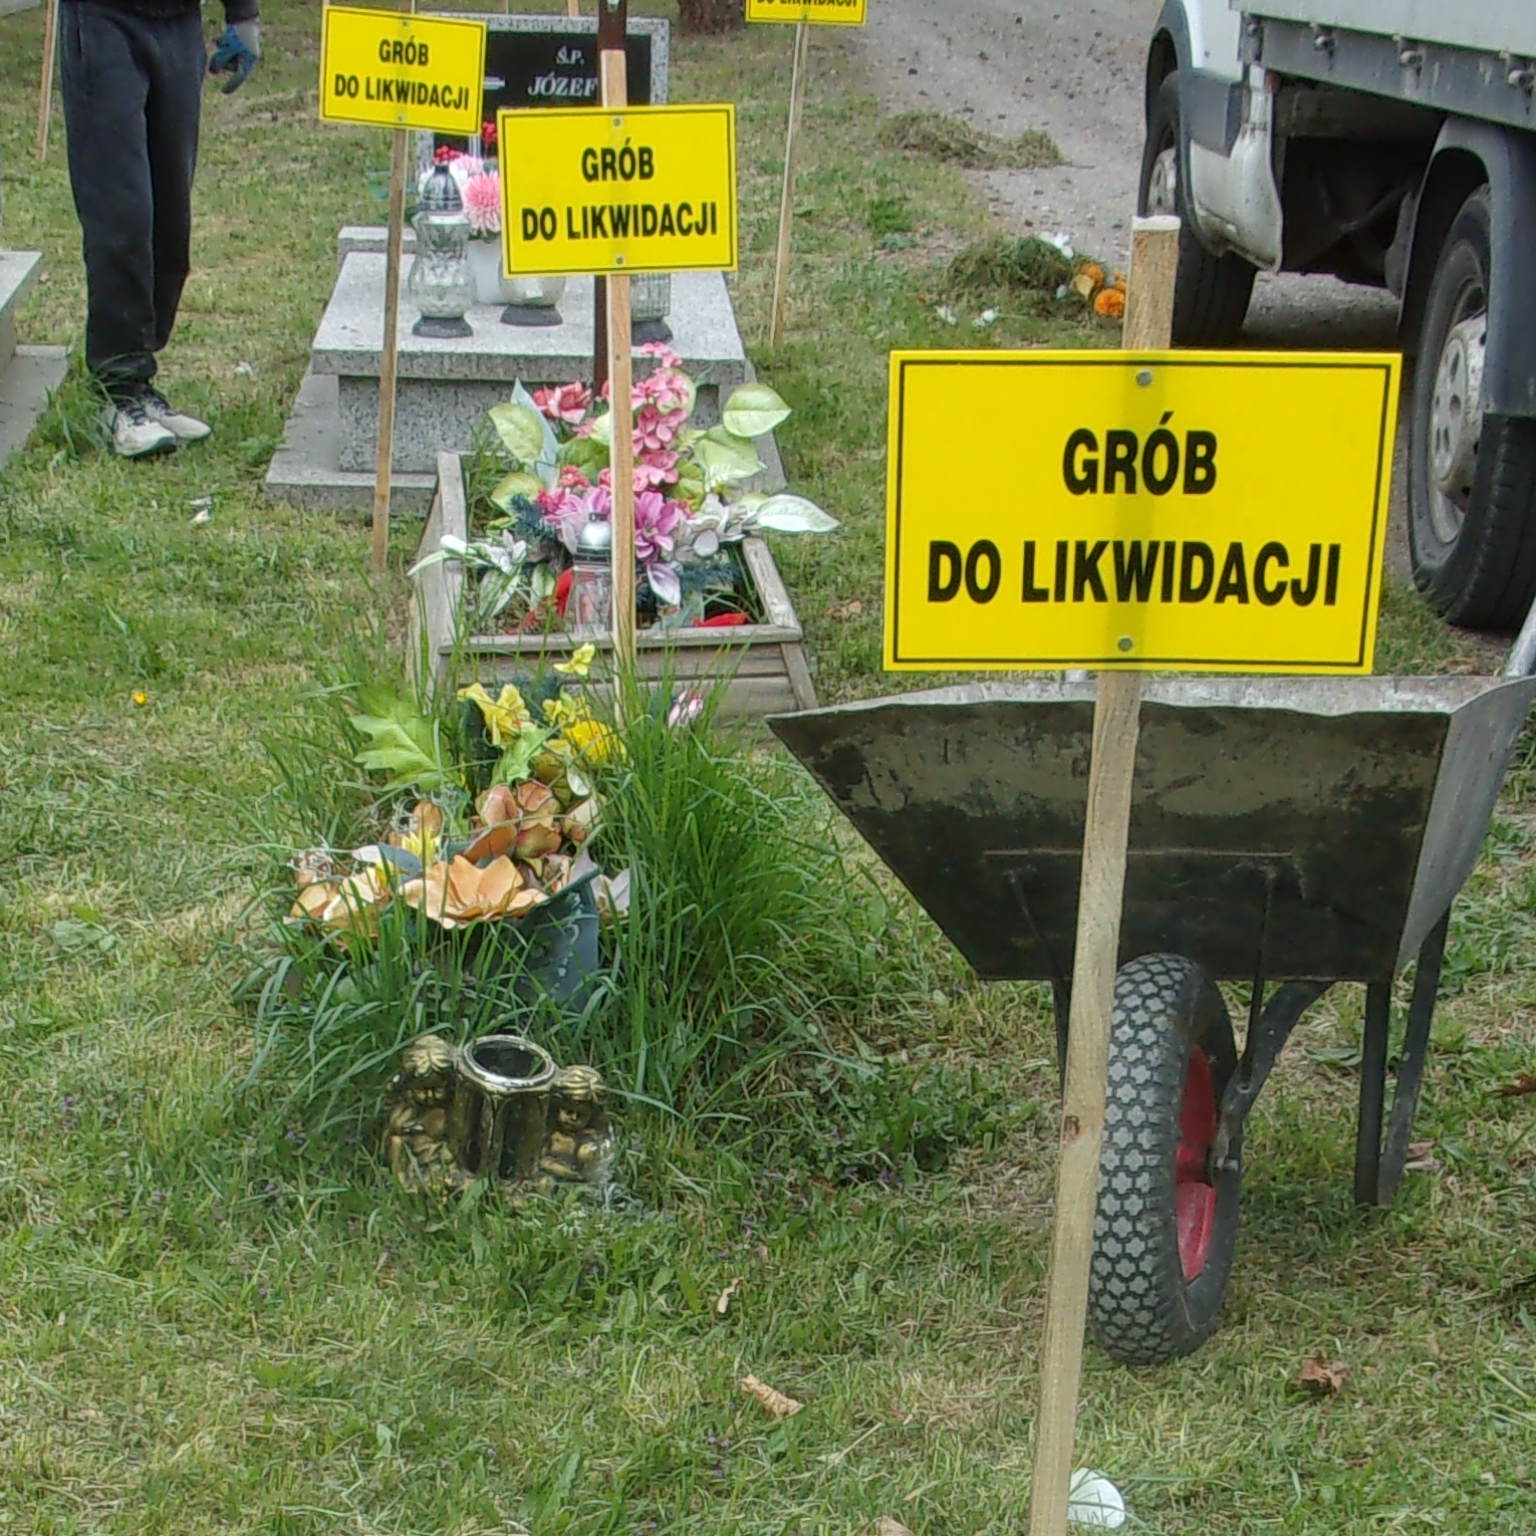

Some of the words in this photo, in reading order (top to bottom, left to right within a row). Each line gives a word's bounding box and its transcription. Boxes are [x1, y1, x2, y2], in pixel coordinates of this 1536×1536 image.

[379, 35, 429, 66] GRÓB
[334, 73, 360, 98] DO
[365, 76, 469, 111] LIKWIDACJI
[527, 72, 598, 97] JÓZEF
[581, 137, 655, 183] GRÓB
[521, 206, 558, 242] DO
[566, 201, 718, 240] LIKWIDACJI
[1062, 411, 1218, 496] GRÓB
[927, 539, 1001, 605] DO
[1020, 540, 1341, 607] LIKWIDACJI
